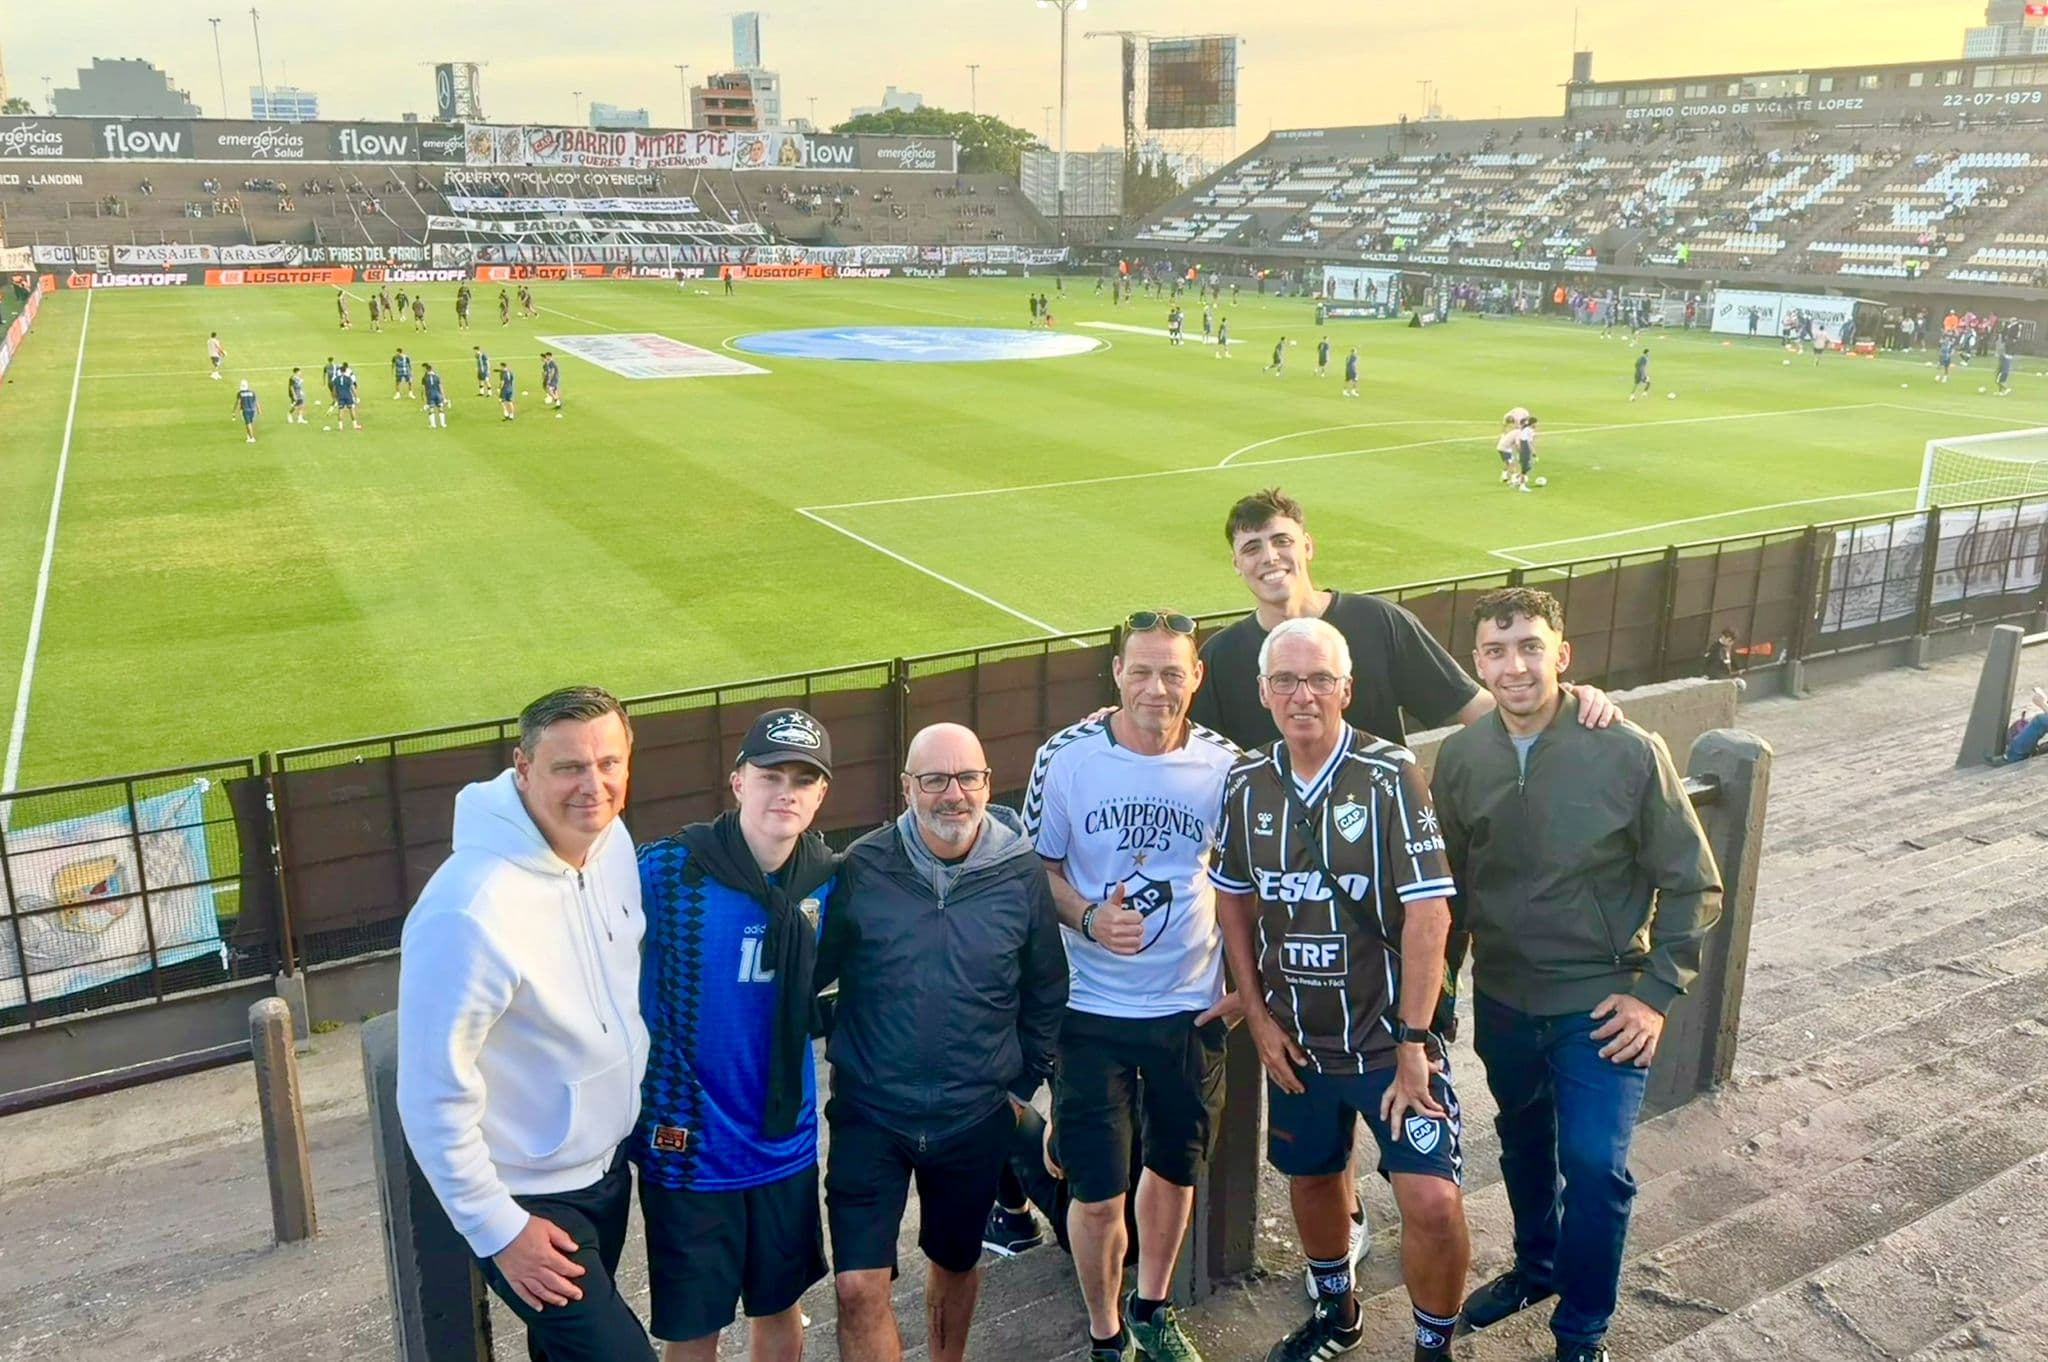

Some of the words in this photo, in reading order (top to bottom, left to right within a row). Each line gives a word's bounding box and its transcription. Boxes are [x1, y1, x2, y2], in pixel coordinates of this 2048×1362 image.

[1942, 91, 2042, 106] 22-07-1979
[1626, 105, 1674, 119] ESTADIO
[1681, 103, 1727, 116] CIUDAD
[1732, 103, 1750, 114] DE
[1818, 98, 1864, 110] LOPEZ
[103, 124, 181, 153] flow
[218, 132, 304, 148] emergencias
[338, 129, 408, 155] flow
[561, 130, 626, 156] BARRIO
[30, 144, 63, 155] Salud
[274, 147, 304, 158] Salud
[805, 139, 854, 164] flow
[877, 147, 936, 161] emergencias
[561, 154, 573, 164] SI
[578, 154, 622, 167] QUERES
[136, 247, 199, 260] PASAJE
[303, 247, 327, 262] LOS
[1084, 803, 1204, 843] CAMPEONES
[1339, 809, 1361, 829] CAP
[1116, 826, 1172, 852] 2025
[1283, 941, 1340, 968] TRF
[1413, 1122, 1432, 1139] CAP
